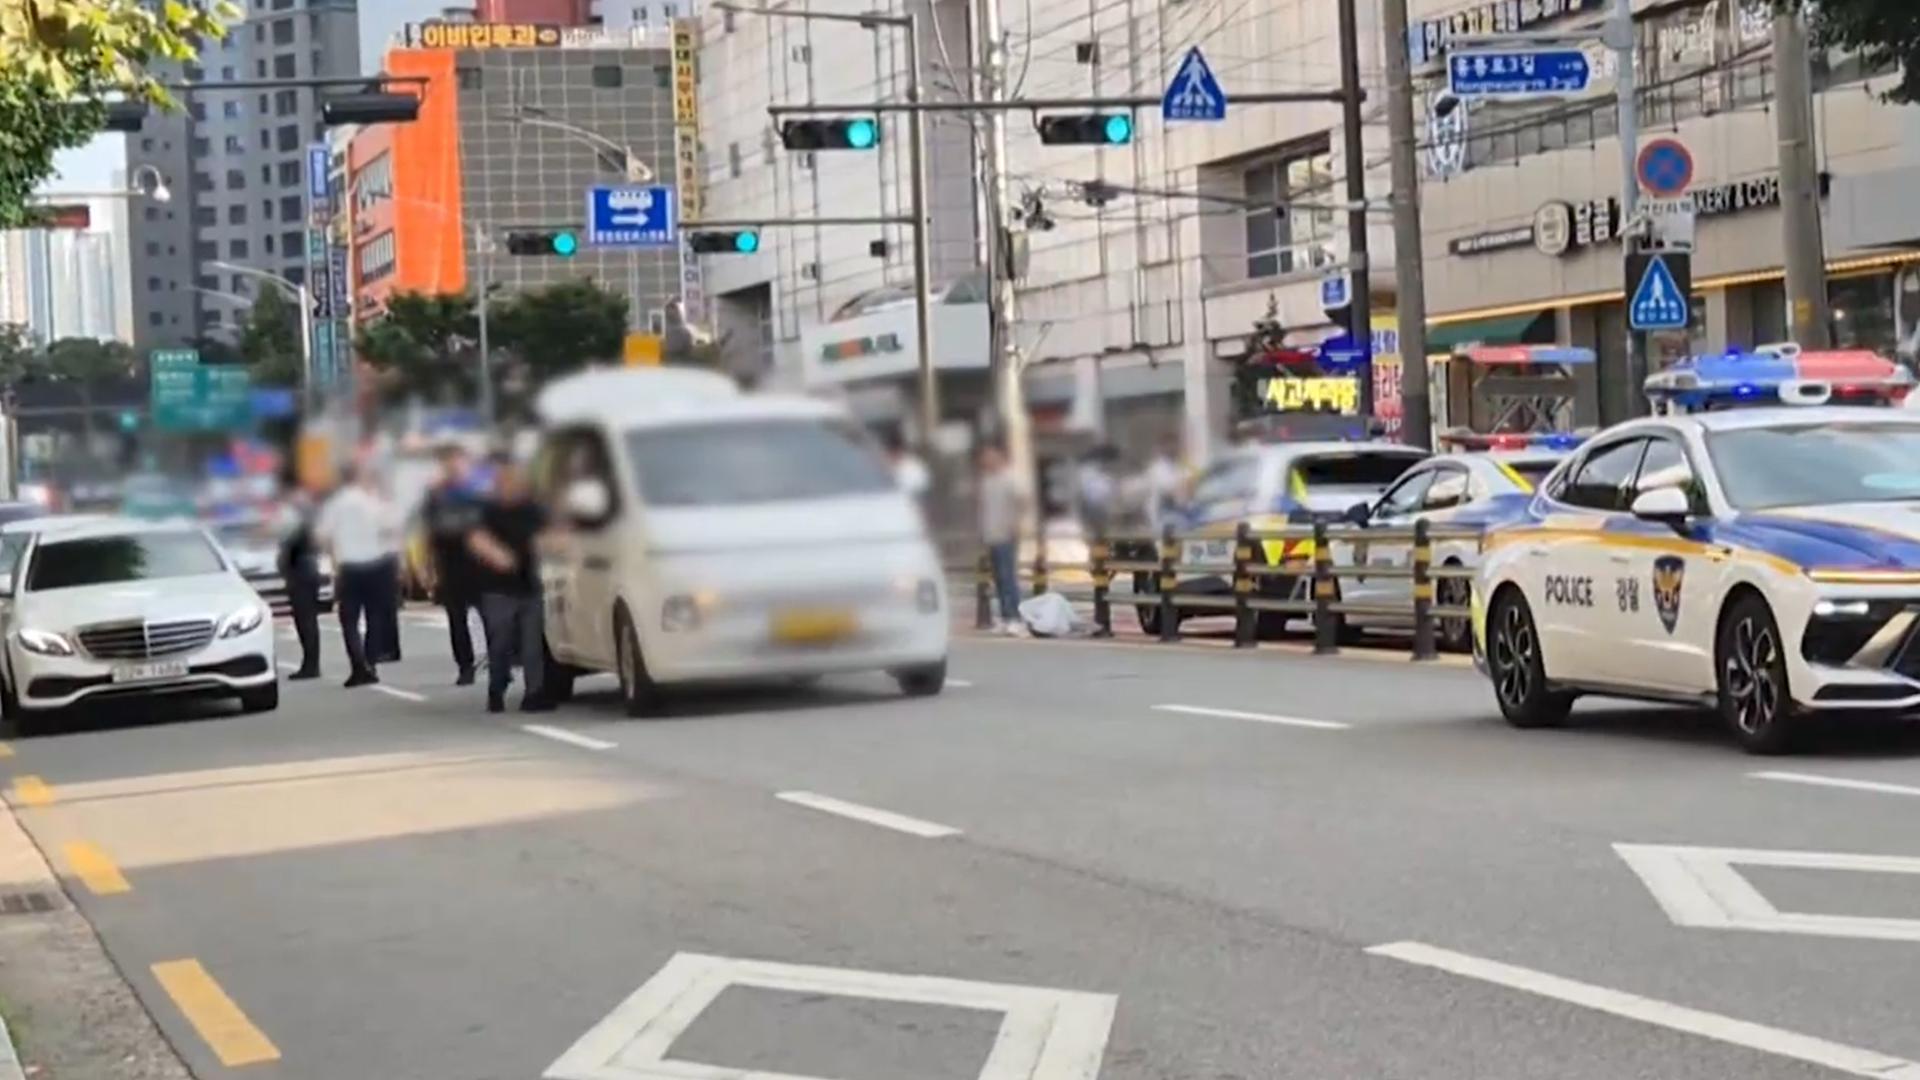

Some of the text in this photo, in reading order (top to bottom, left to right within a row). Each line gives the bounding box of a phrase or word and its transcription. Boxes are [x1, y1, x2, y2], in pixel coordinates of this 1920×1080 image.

[424, 24, 537, 47] 이비인후과
[1690, 183, 1731, 213] KERY
[1545, 574, 1594, 608] POLICE
[1616, 577, 1640, 613] 경찰
